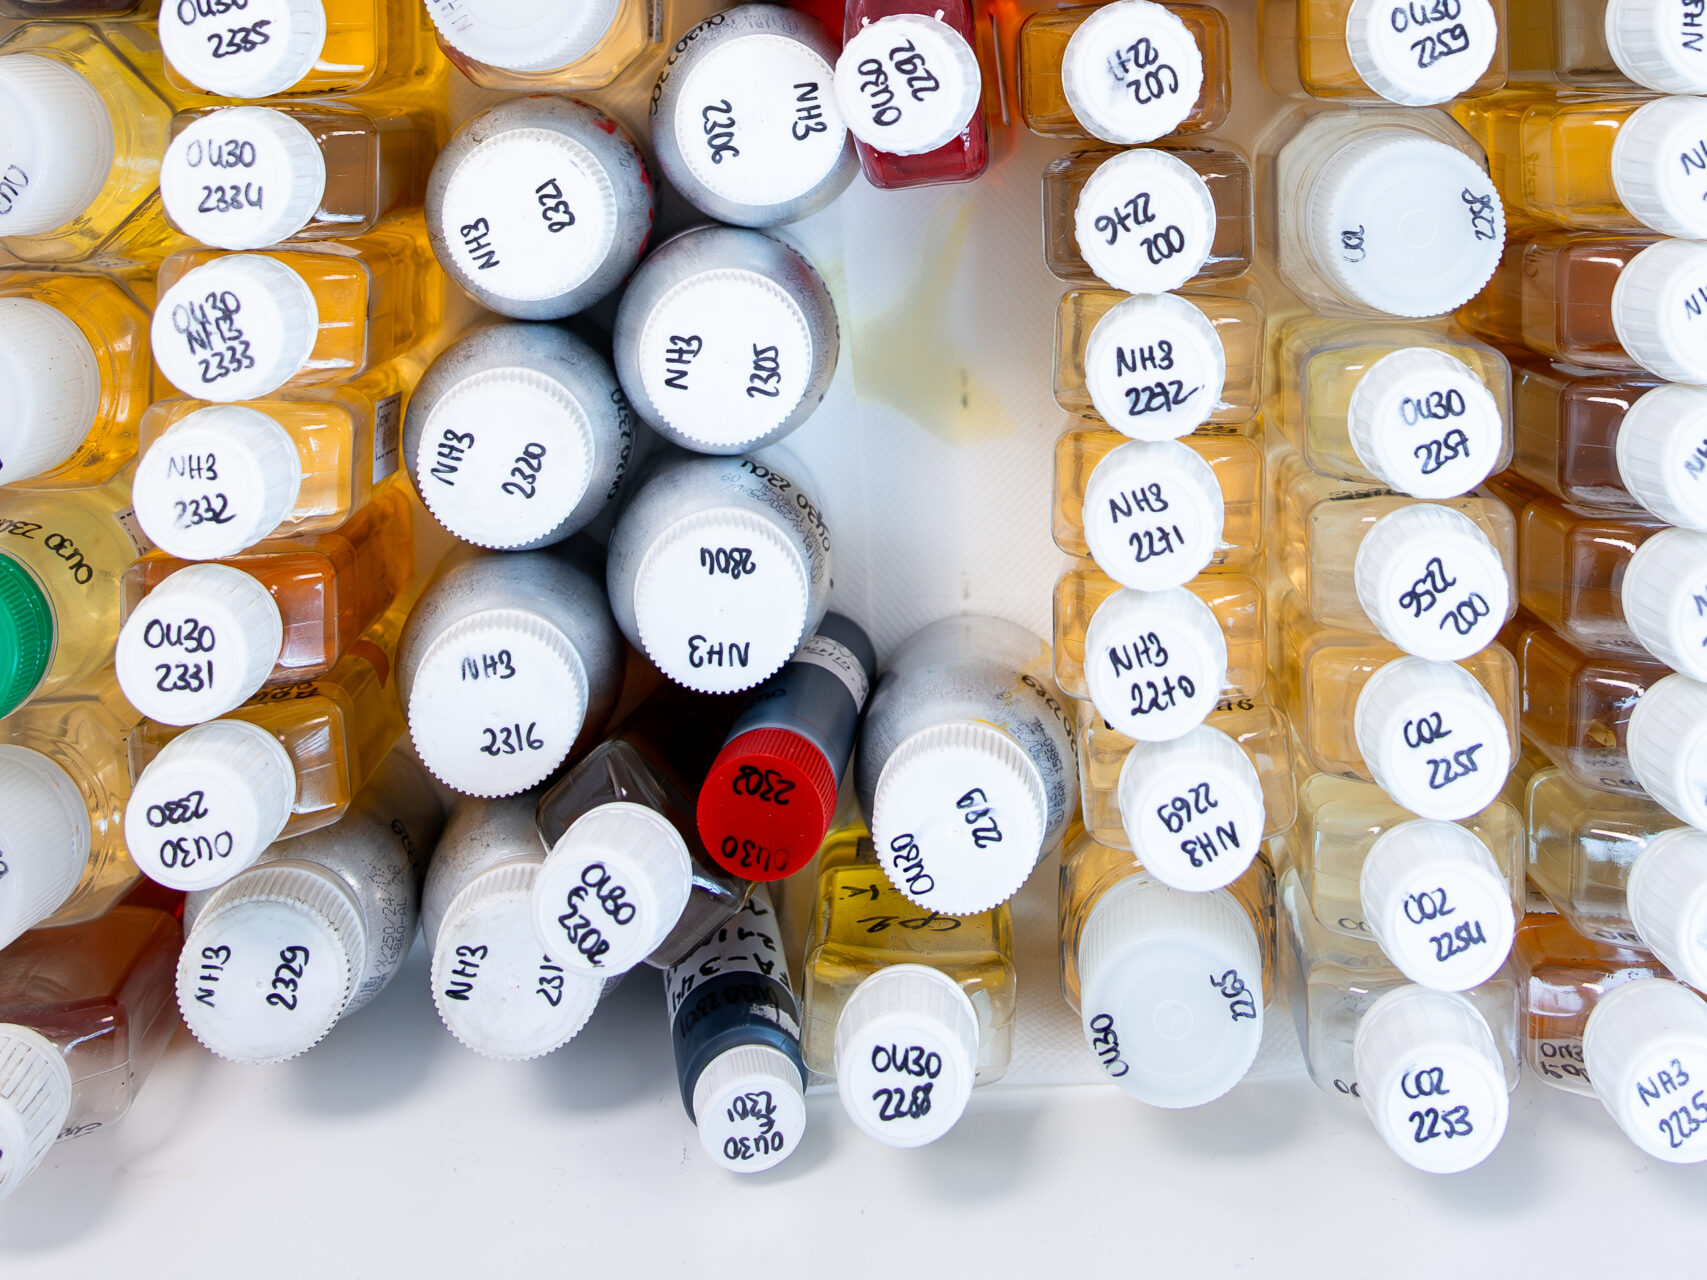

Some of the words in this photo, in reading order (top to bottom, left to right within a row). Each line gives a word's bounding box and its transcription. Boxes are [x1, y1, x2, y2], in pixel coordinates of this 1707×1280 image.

[207, 19, 272, 59] 2335
[1410, 23, 1470, 68] 2259
[889, 39, 940, 102] 2292
[702, 99, 740, 164] 2306
[198, 340, 255, 383] 2333
[746, 343, 781, 398] 2305
[501, 443, 546, 499] 2320
[155, 660, 213, 693] 2331
[480, 722, 544, 756] 2316
[146, 790, 208, 828] 2330
[1157, 782, 1218, 833] 2269
[266, 945, 310, 1011] 2329
[536, 952, 566, 1007] 231
[1408, 1105, 1473, 1143] 2253
